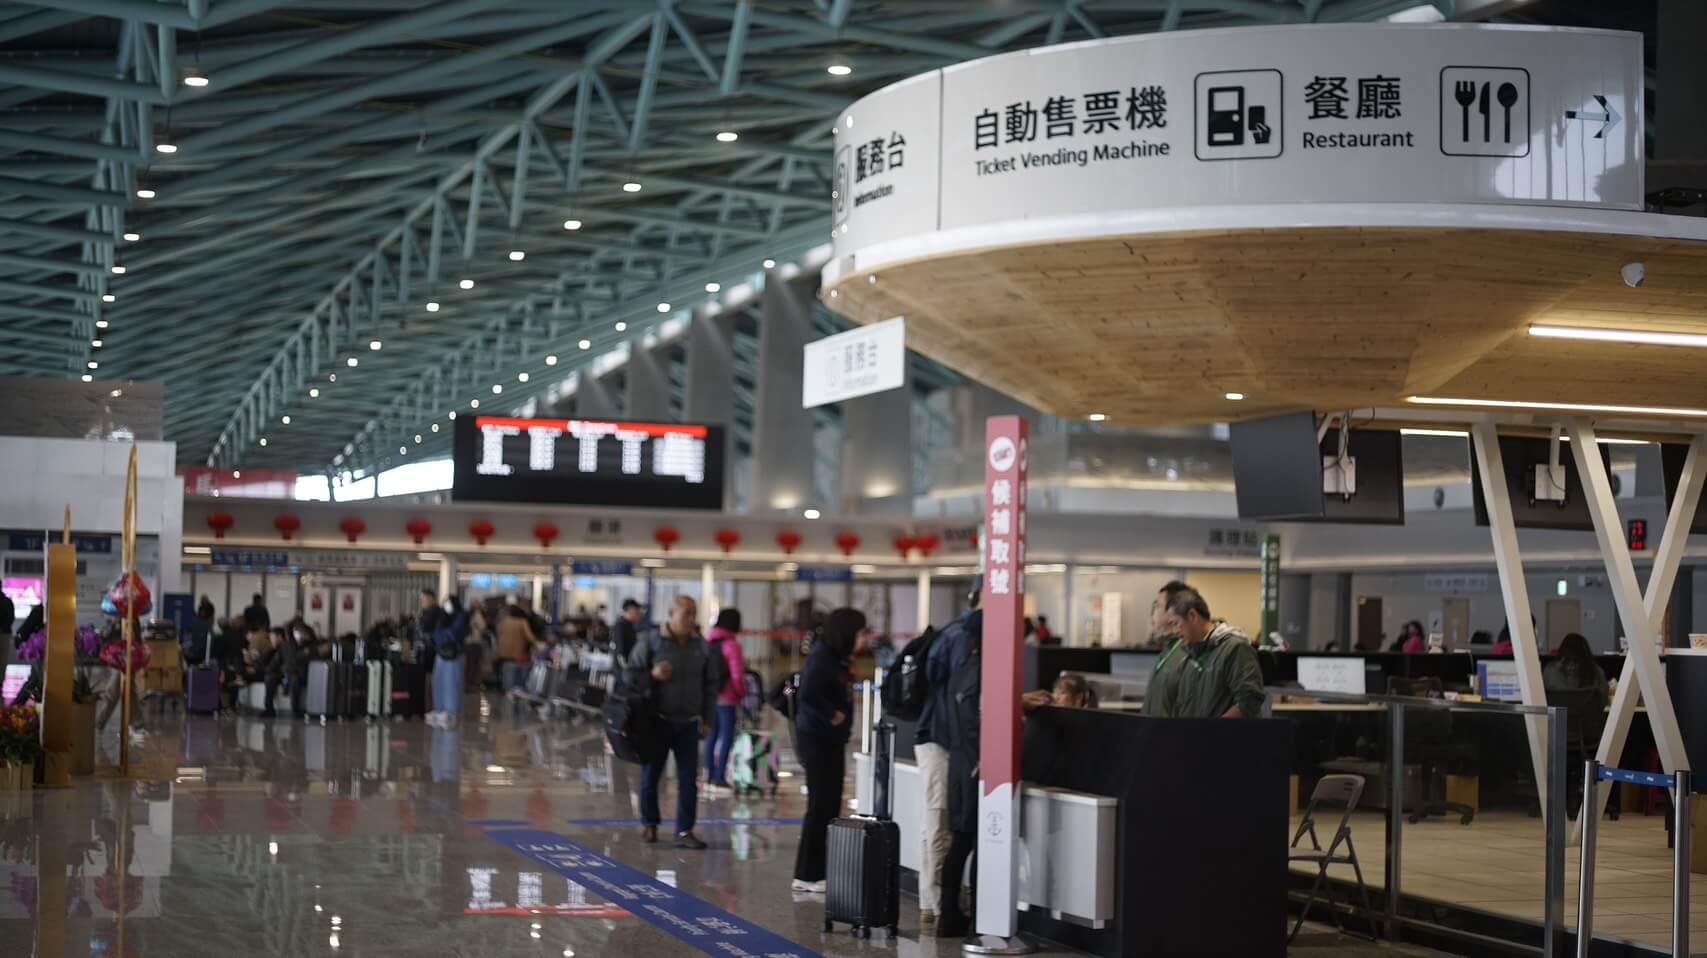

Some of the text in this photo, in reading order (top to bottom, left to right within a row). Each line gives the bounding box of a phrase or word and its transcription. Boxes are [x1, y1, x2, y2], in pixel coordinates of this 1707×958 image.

[974, 85, 1168, 151] 自動售票機
[1303, 75, 1402, 121] 餐廳
[976, 140, 1170, 176] Ticket Vending Machine
[1303, 130, 1414, 149] Restaurant
[989, 479, 1012, 594] 候補取號
